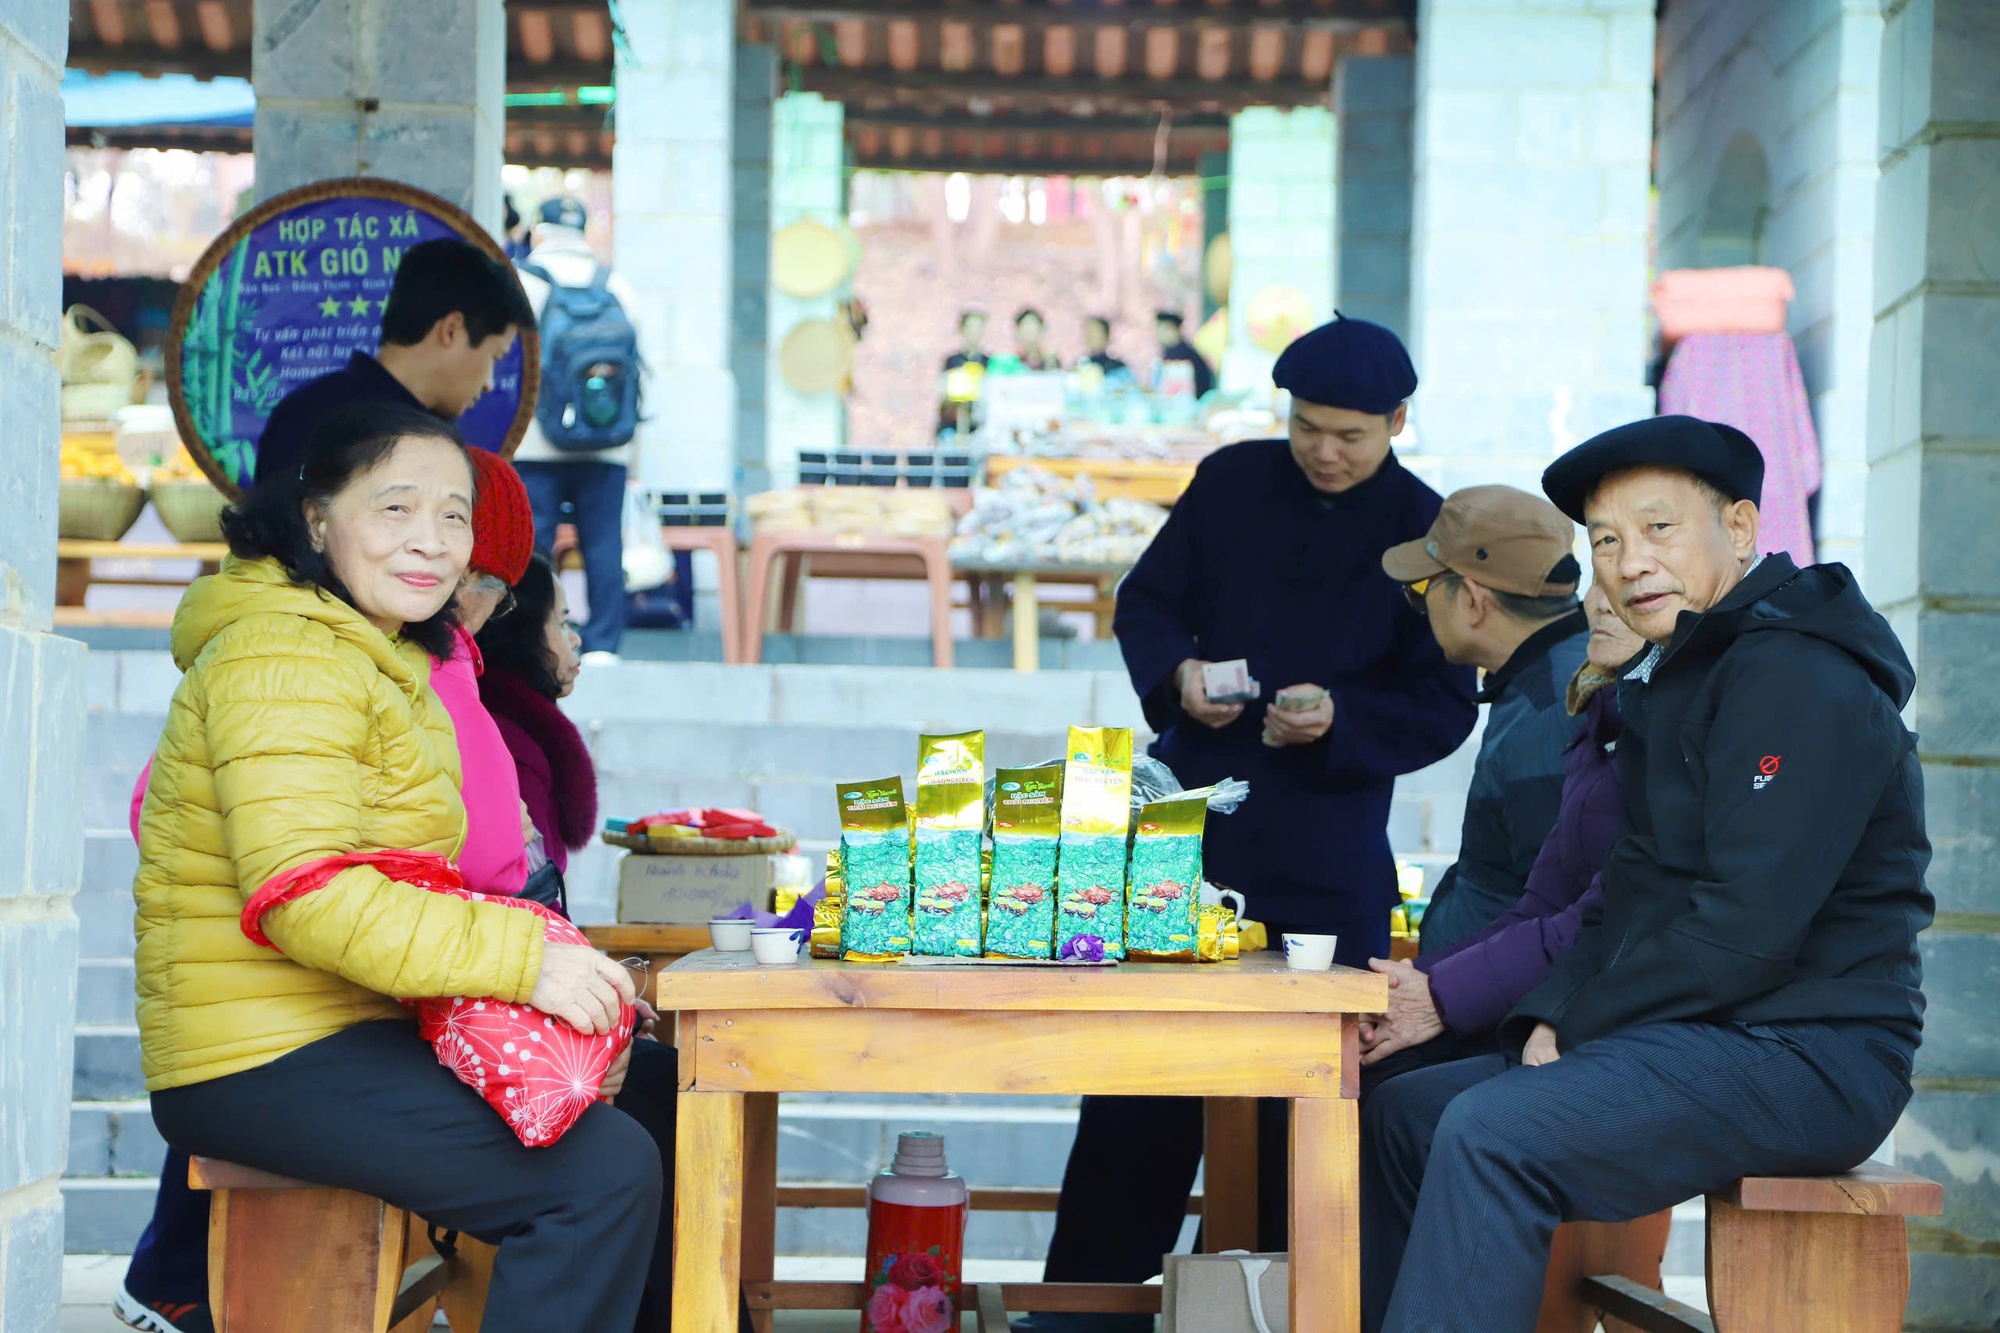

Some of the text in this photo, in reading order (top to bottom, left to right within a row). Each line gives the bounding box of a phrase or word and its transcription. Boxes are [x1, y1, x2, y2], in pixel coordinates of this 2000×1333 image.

[279, 210, 419, 245] HỢP TÁC XÃ
[254, 250, 308, 278] ATK
[320, 241, 369, 276] GIÓ
